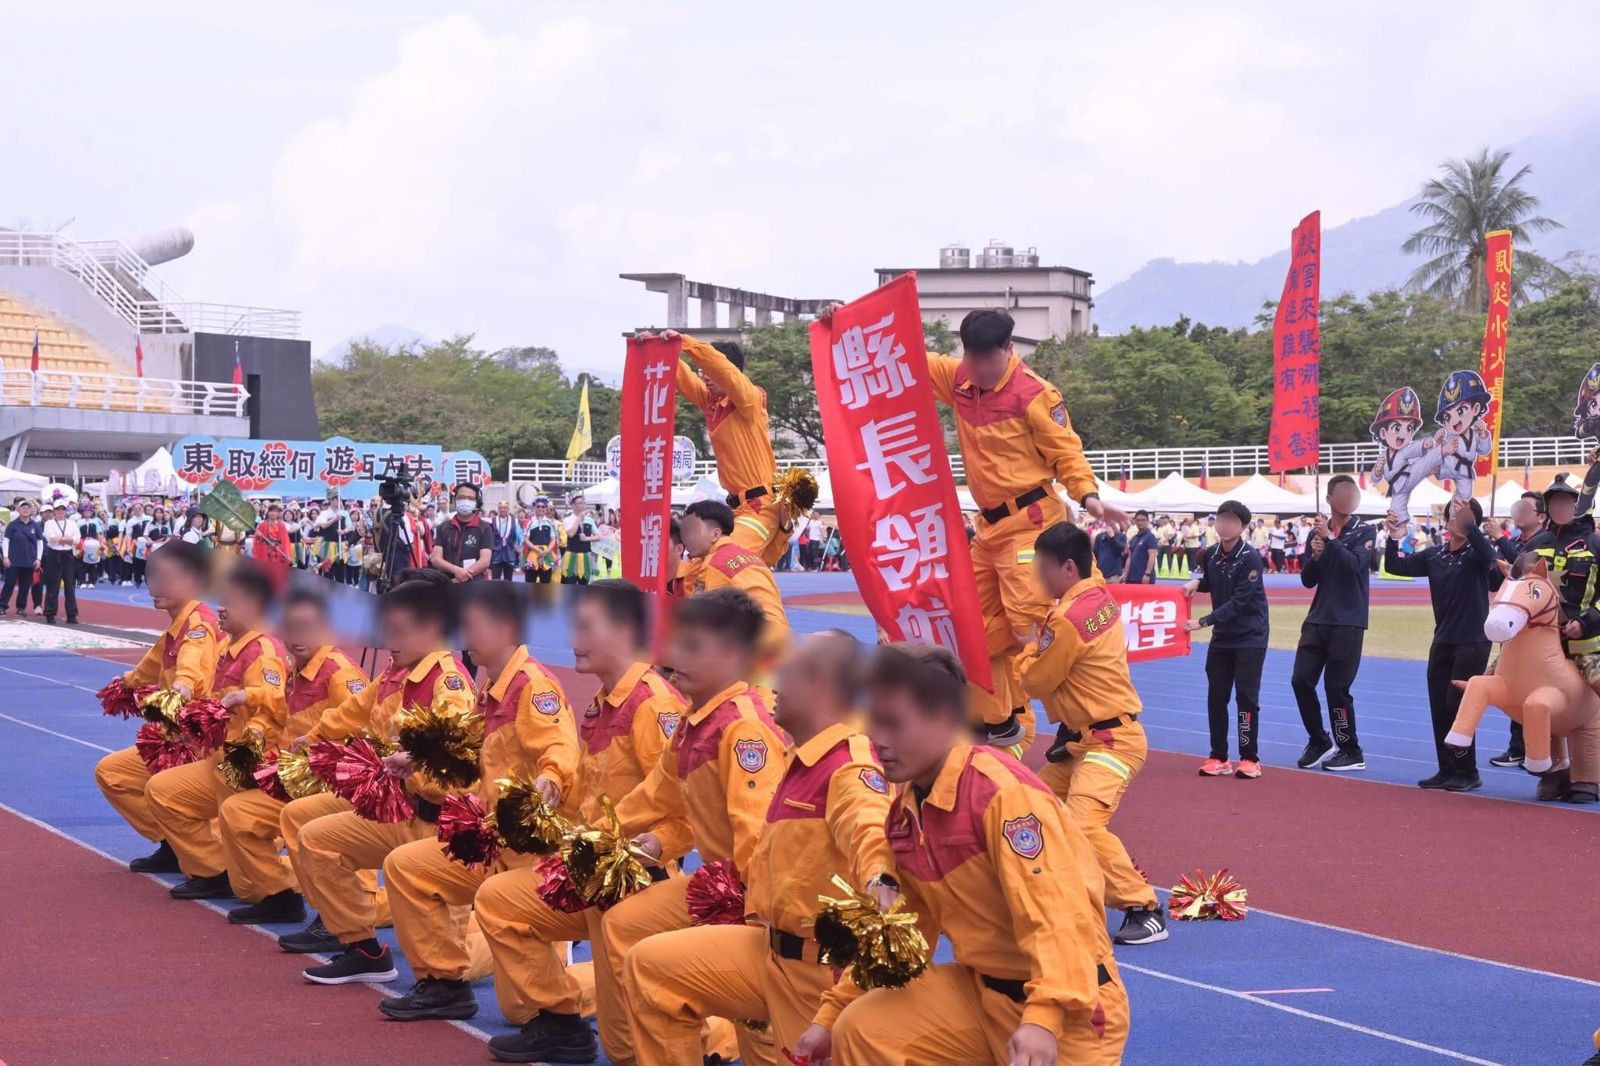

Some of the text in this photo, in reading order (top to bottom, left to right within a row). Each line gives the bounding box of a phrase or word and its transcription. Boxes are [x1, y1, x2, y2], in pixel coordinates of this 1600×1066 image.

[640, 361, 671, 593] 花蓮輝
[831, 311, 960, 658] 縣長領航
[1120, 600, 1177, 651] 煌
[1239, 711, 1251, 747] FILA
[1333, 707, 1350, 744] FILA
